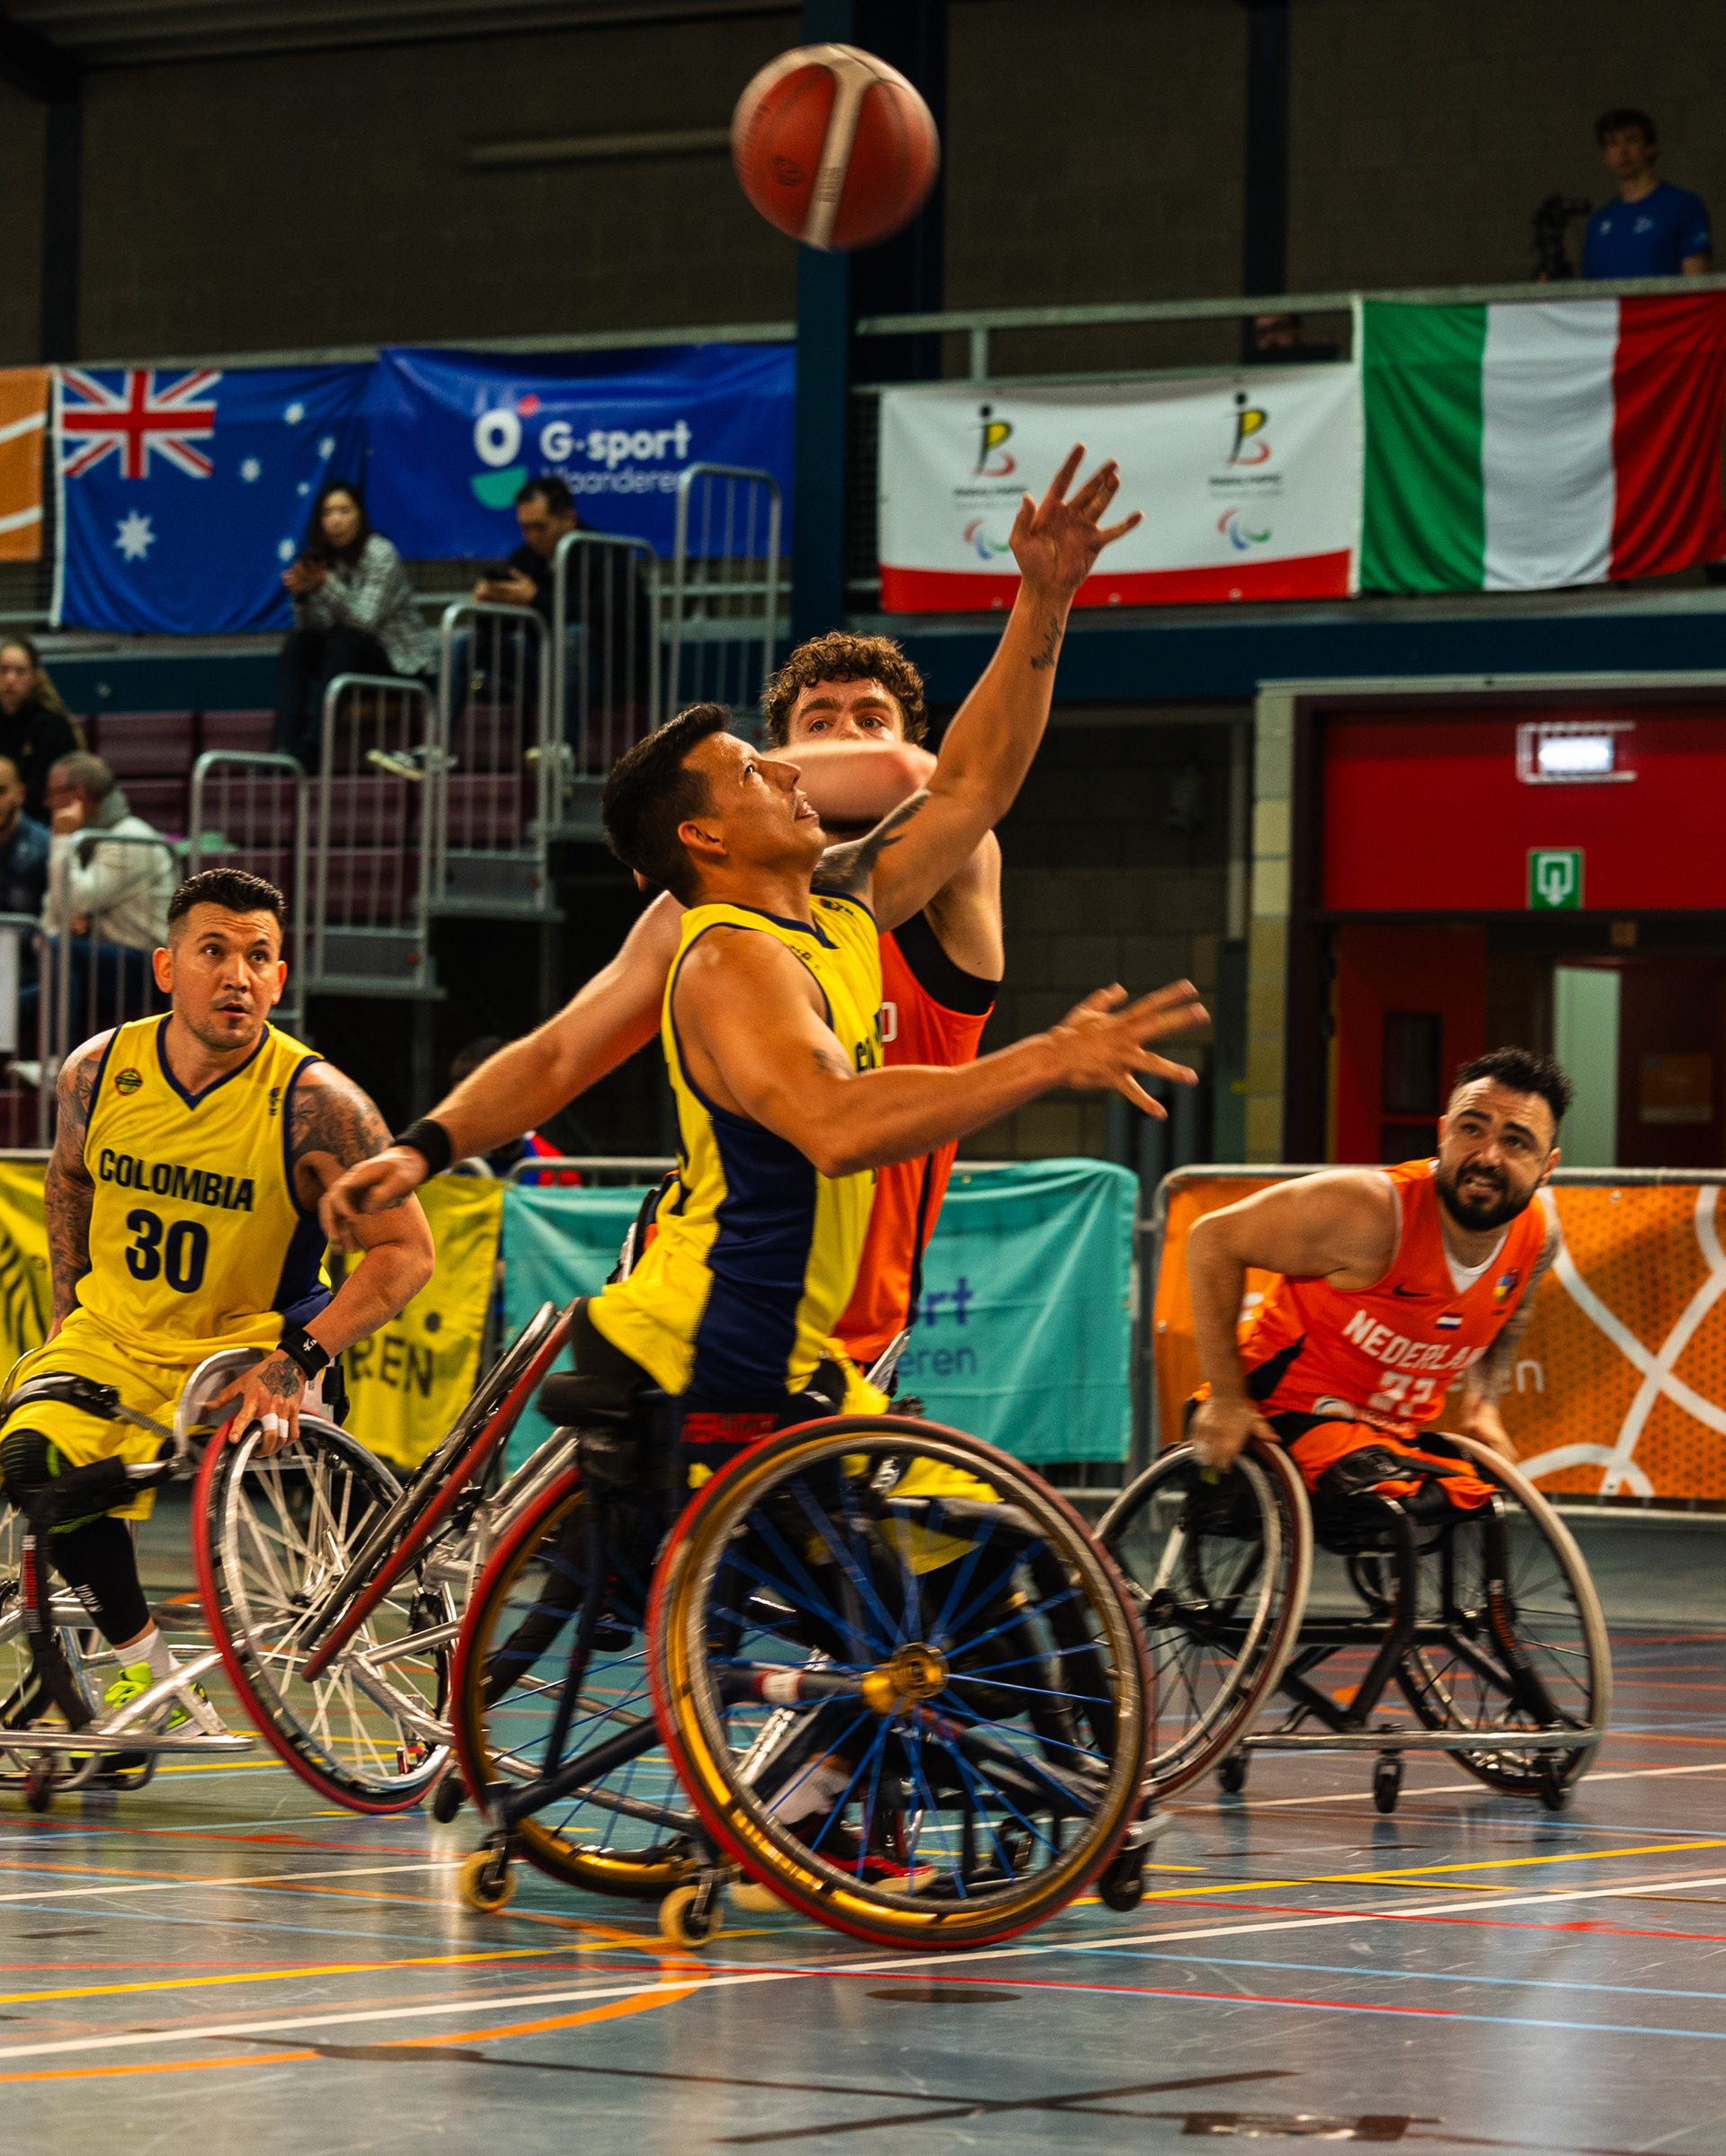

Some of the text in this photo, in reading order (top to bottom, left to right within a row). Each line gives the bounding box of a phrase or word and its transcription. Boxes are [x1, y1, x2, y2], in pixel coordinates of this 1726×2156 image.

[100, 1148, 255, 1212] COLOMBIA
[125, 1208, 209, 1294] 30
[348, 1334, 434, 1399] REN
[894, 1348, 978, 1379] eren
